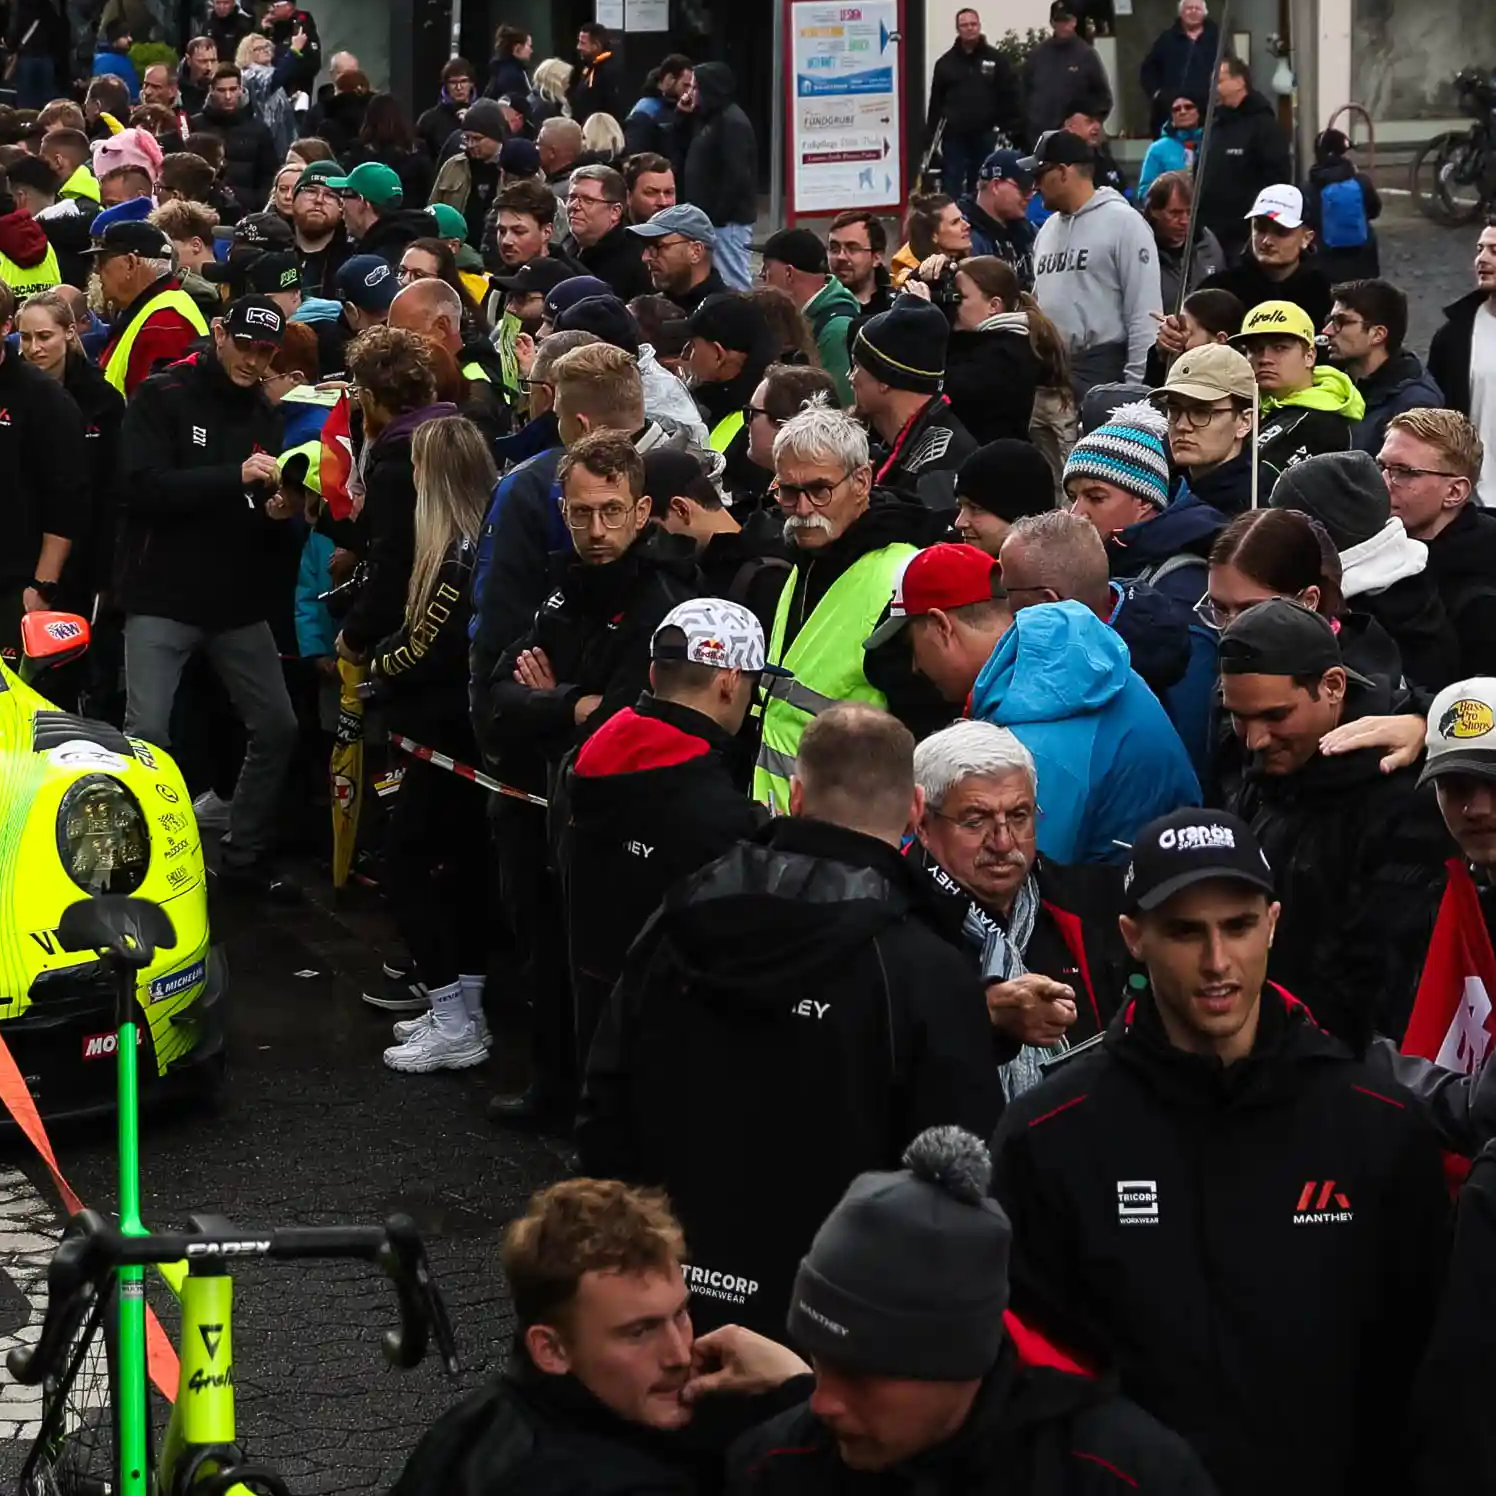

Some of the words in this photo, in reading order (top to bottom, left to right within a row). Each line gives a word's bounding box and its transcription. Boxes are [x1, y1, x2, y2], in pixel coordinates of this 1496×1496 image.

[1458, 701, 1484, 712] Bass
[1460, 720, 1492, 734] Shops
[164, 965, 204, 993] MICHELIN
[1118, 1192, 1158, 1202] TRICORP
[1119, 1216, 1159, 1225] WORKWEAR
[1293, 1212, 1354, 1224] MANTHEY
[680, 1263, 759, 1295] TRICORP
[690, 1284, 746, 1305] WORKWEAR
